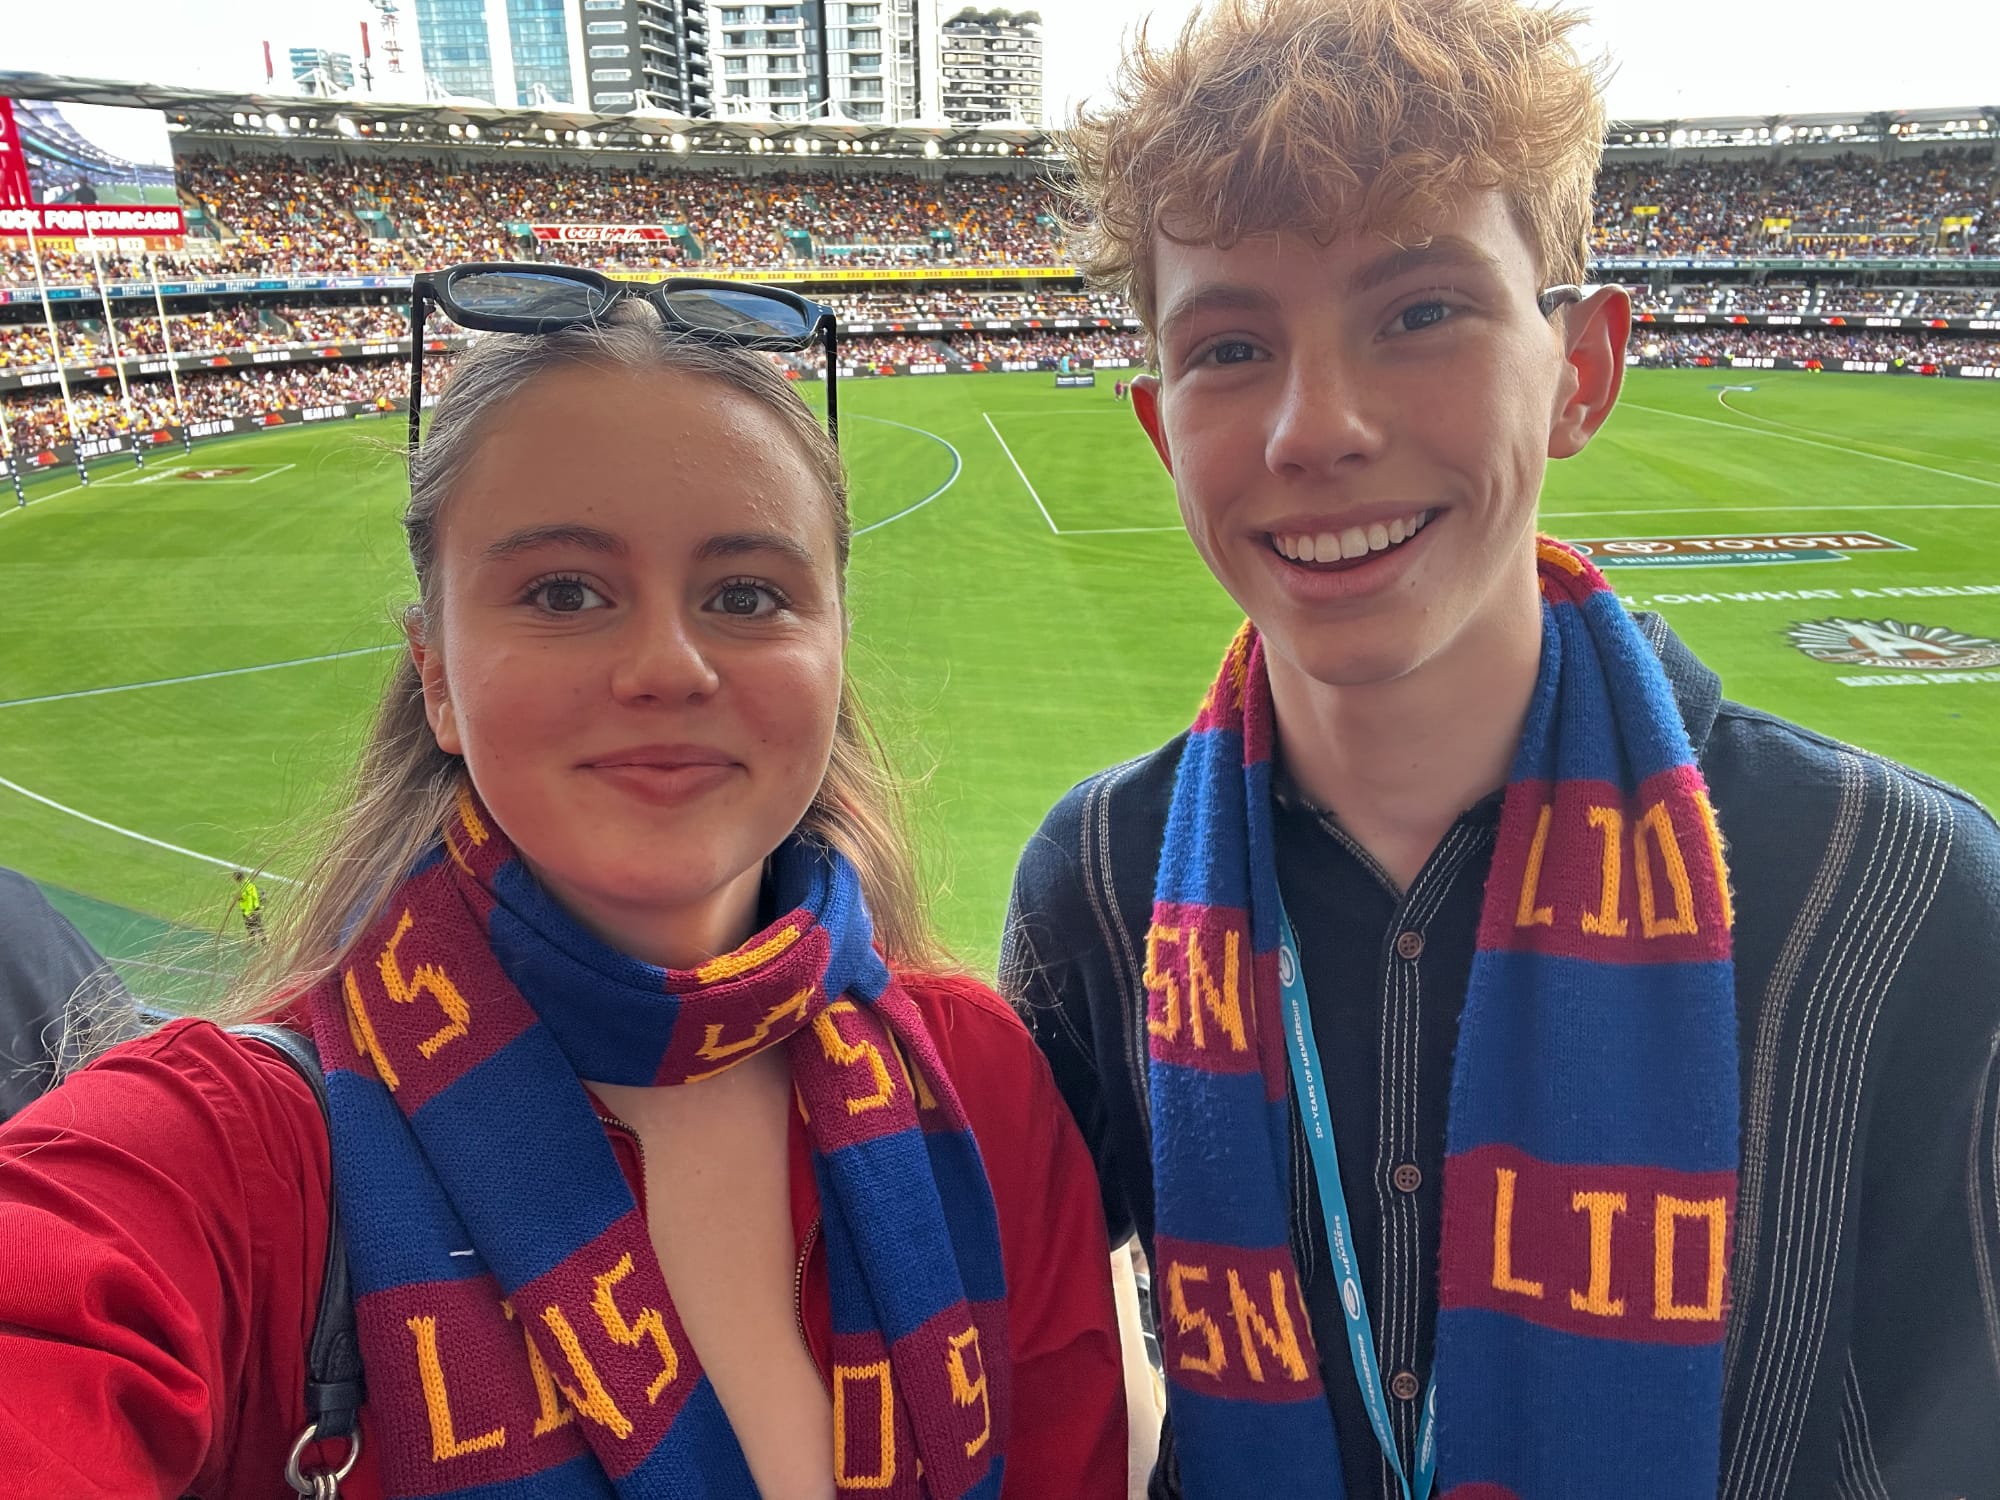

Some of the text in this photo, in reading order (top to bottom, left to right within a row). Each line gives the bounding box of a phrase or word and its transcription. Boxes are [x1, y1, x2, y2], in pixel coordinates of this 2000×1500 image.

[44, 210, 84, 229] FOR
[90, 210, 179, 229] STARCASH
[1681, 536, 1884, 550] TOYOTA
[1653, 593, 1722, 604] OH
[1716, 589, 1843, 602] WHAT
[1850, 588, 1886, 598] A
[1291, 999, 1311, 1067] MEMBERSHIP
[1304, 1067, 1314, 1084] OF
[1307, 1083, 1319, 1120] YEARS
